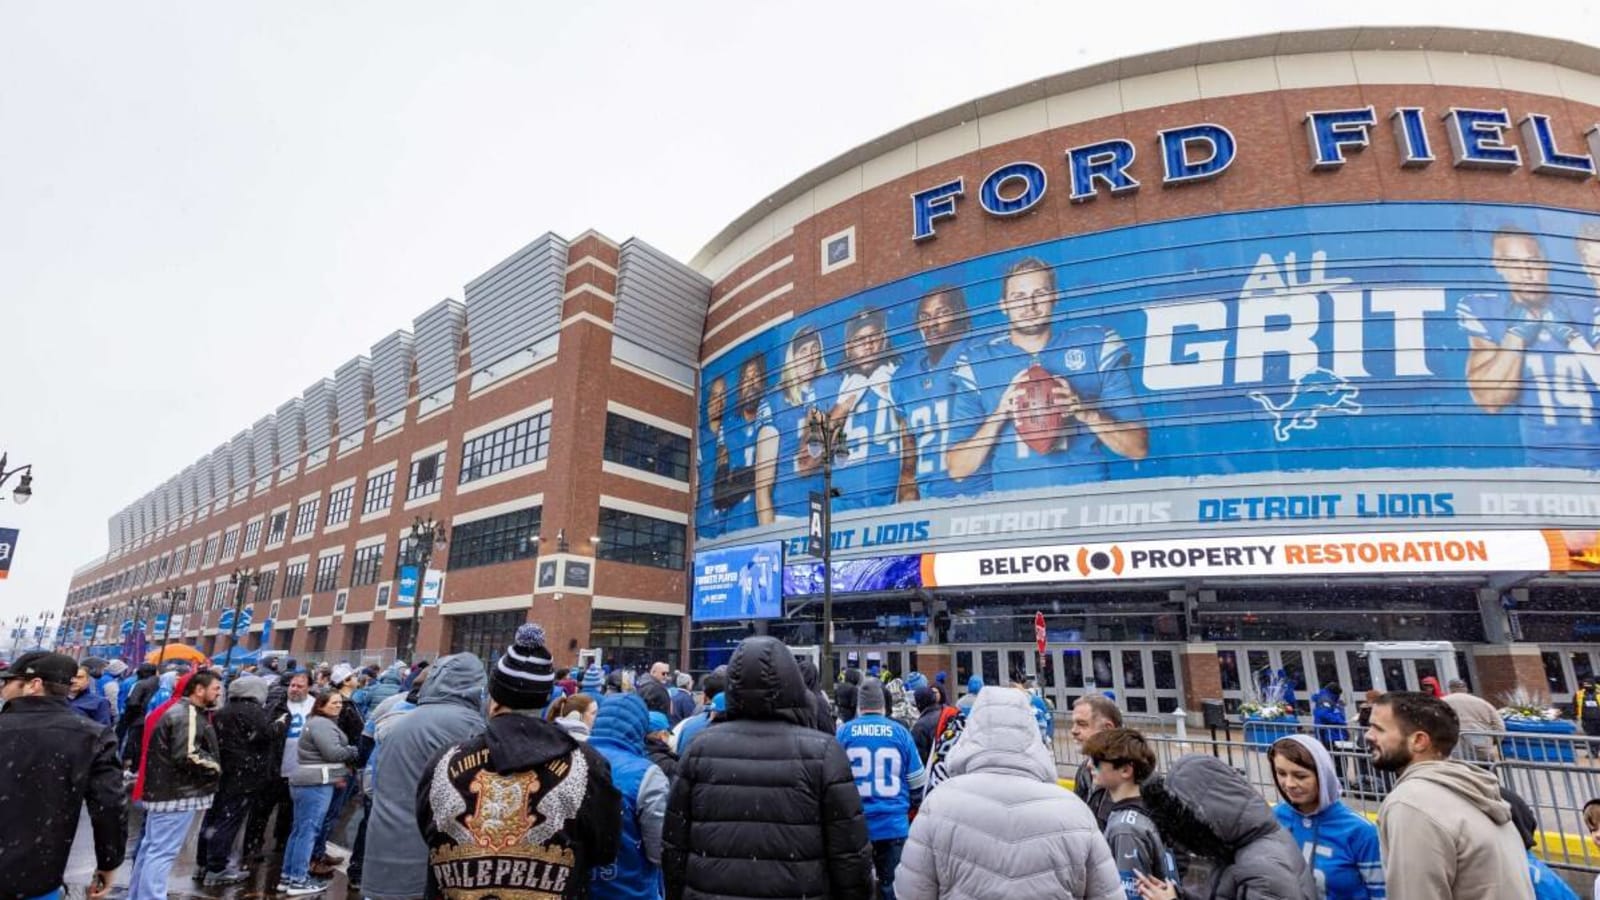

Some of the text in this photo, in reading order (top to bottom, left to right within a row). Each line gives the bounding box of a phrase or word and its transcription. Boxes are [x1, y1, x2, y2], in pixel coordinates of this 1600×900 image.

[910, 104, 1600, 241] FORD FIEL
[1239, 250, 1354, 298] ALL
[1140, 287, 1446, 390] GRIT
[1525, 353, 1593, 425] 14
[841, 400, 897, 461] 54
[911, 400, 950, 475] 21
[810, 511, 822, 538] A
[950, 500, 1172, 536] DETROIT LIONS
[1199, 492, 1455, 523] DETROIT LIONS
[787, 520, 930, 556] ETIT LIONS
[979, 540, 1489, 576] BELFOR PROPERTY RESTORATION
[851, 724, 893, 737] SANDERS
[450, 748, 491, 778] LIMIT
[846, 747, 902, 797] 20
[1120, 810, 1138, 825] 16
